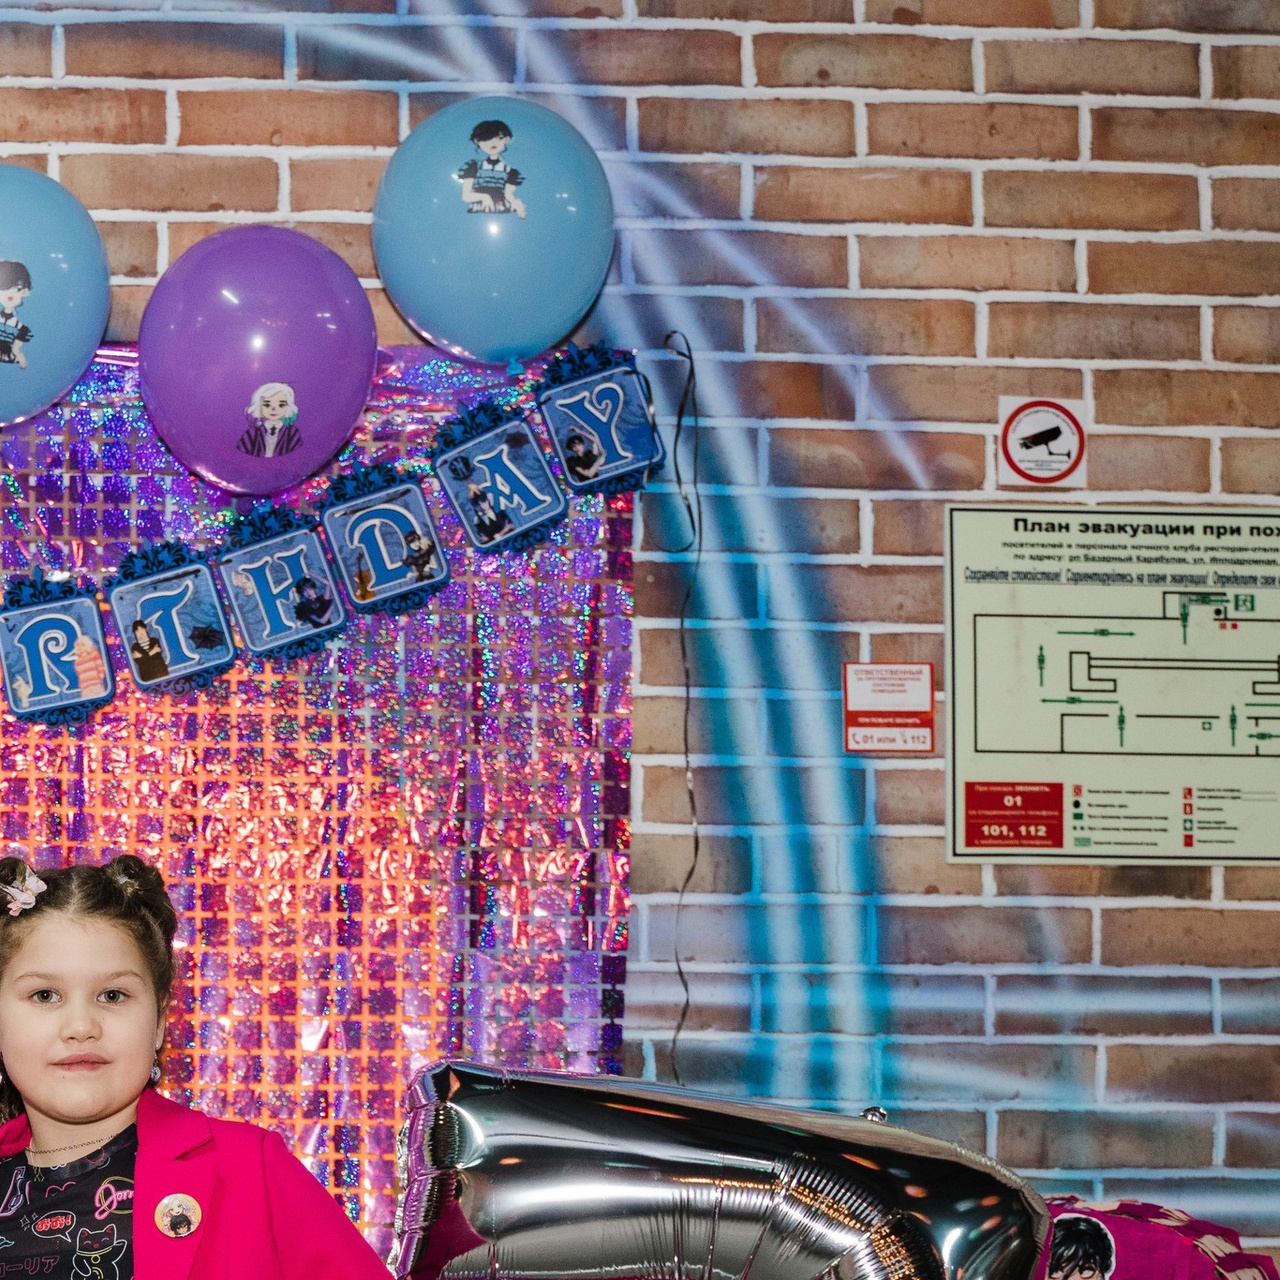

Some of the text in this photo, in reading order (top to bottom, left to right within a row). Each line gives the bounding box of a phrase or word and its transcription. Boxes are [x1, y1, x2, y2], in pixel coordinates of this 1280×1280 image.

[1013, 517, 1070, 533] План
[1078, 522, 1195, 538] эвакуации
[1203, 525, 1242, 539] при
[911, 735, 927, 744] 112
[1003, 795, 1023, 807] 01
[981, 825, 1047, 838] 101, 112
